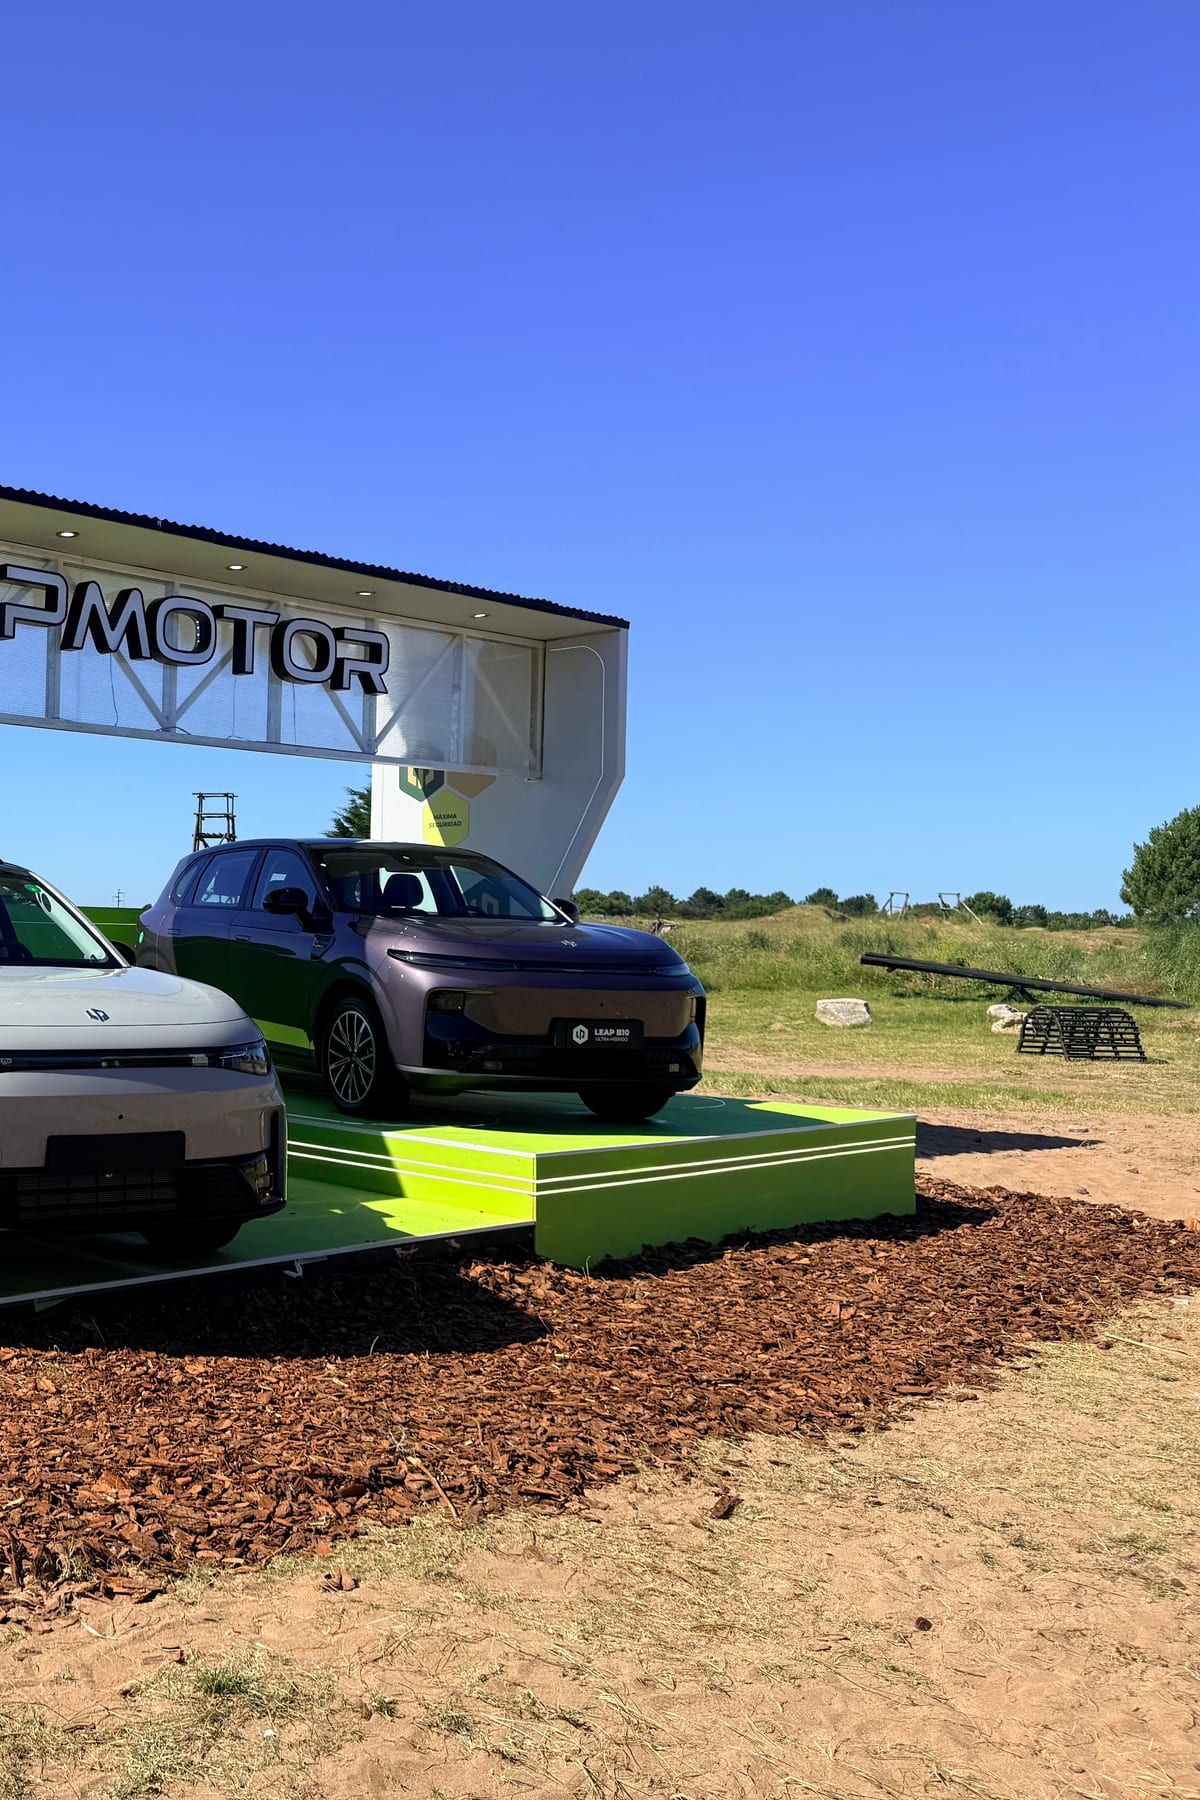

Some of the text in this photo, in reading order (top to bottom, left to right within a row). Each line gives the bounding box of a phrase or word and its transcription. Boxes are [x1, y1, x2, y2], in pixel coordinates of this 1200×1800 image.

[433, 812, 457, 820] MÁXIMA
[428, 820, 462, 828] SEGURIDAD
[594, 1028, 630, 1036] LEAP B10
